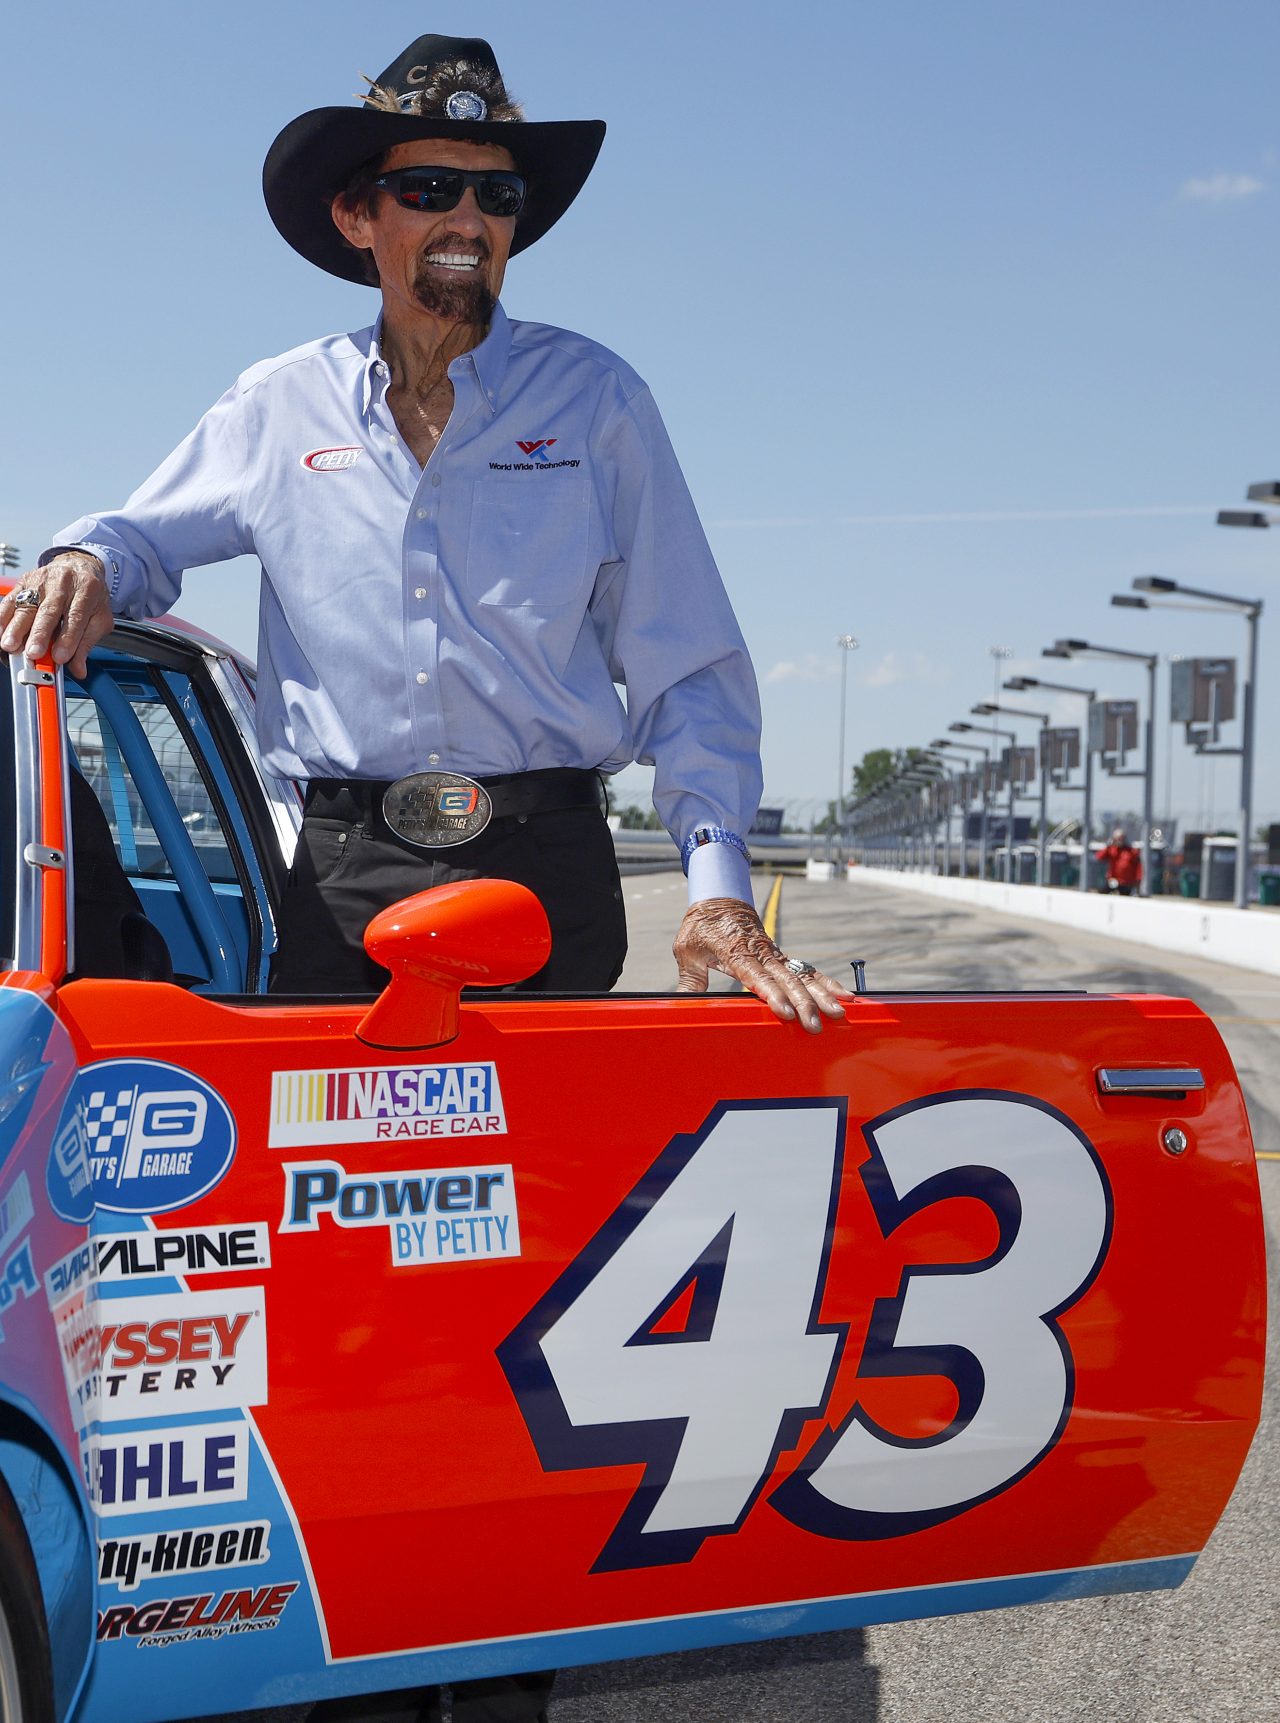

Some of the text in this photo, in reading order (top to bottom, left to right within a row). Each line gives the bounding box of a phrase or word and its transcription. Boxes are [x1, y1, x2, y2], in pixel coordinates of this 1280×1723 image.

[489, 459, 580, 471] World Wide Technology
[347, 1067, 487, 1120] NASCAR
[376, 1115, 501, 1139] RACE CAR
[142, 1152, 193, 1178] GARAGE
[289, 1168, 506, 1226] Power
[396, 1215, 509, 1259] BY PETTY
[495, 1088, 1114, 1575] 43
[98, 1525, 265, 1587] ty-kleen
[139, 1618, 278, 1647] Forged Alloy Wheels
